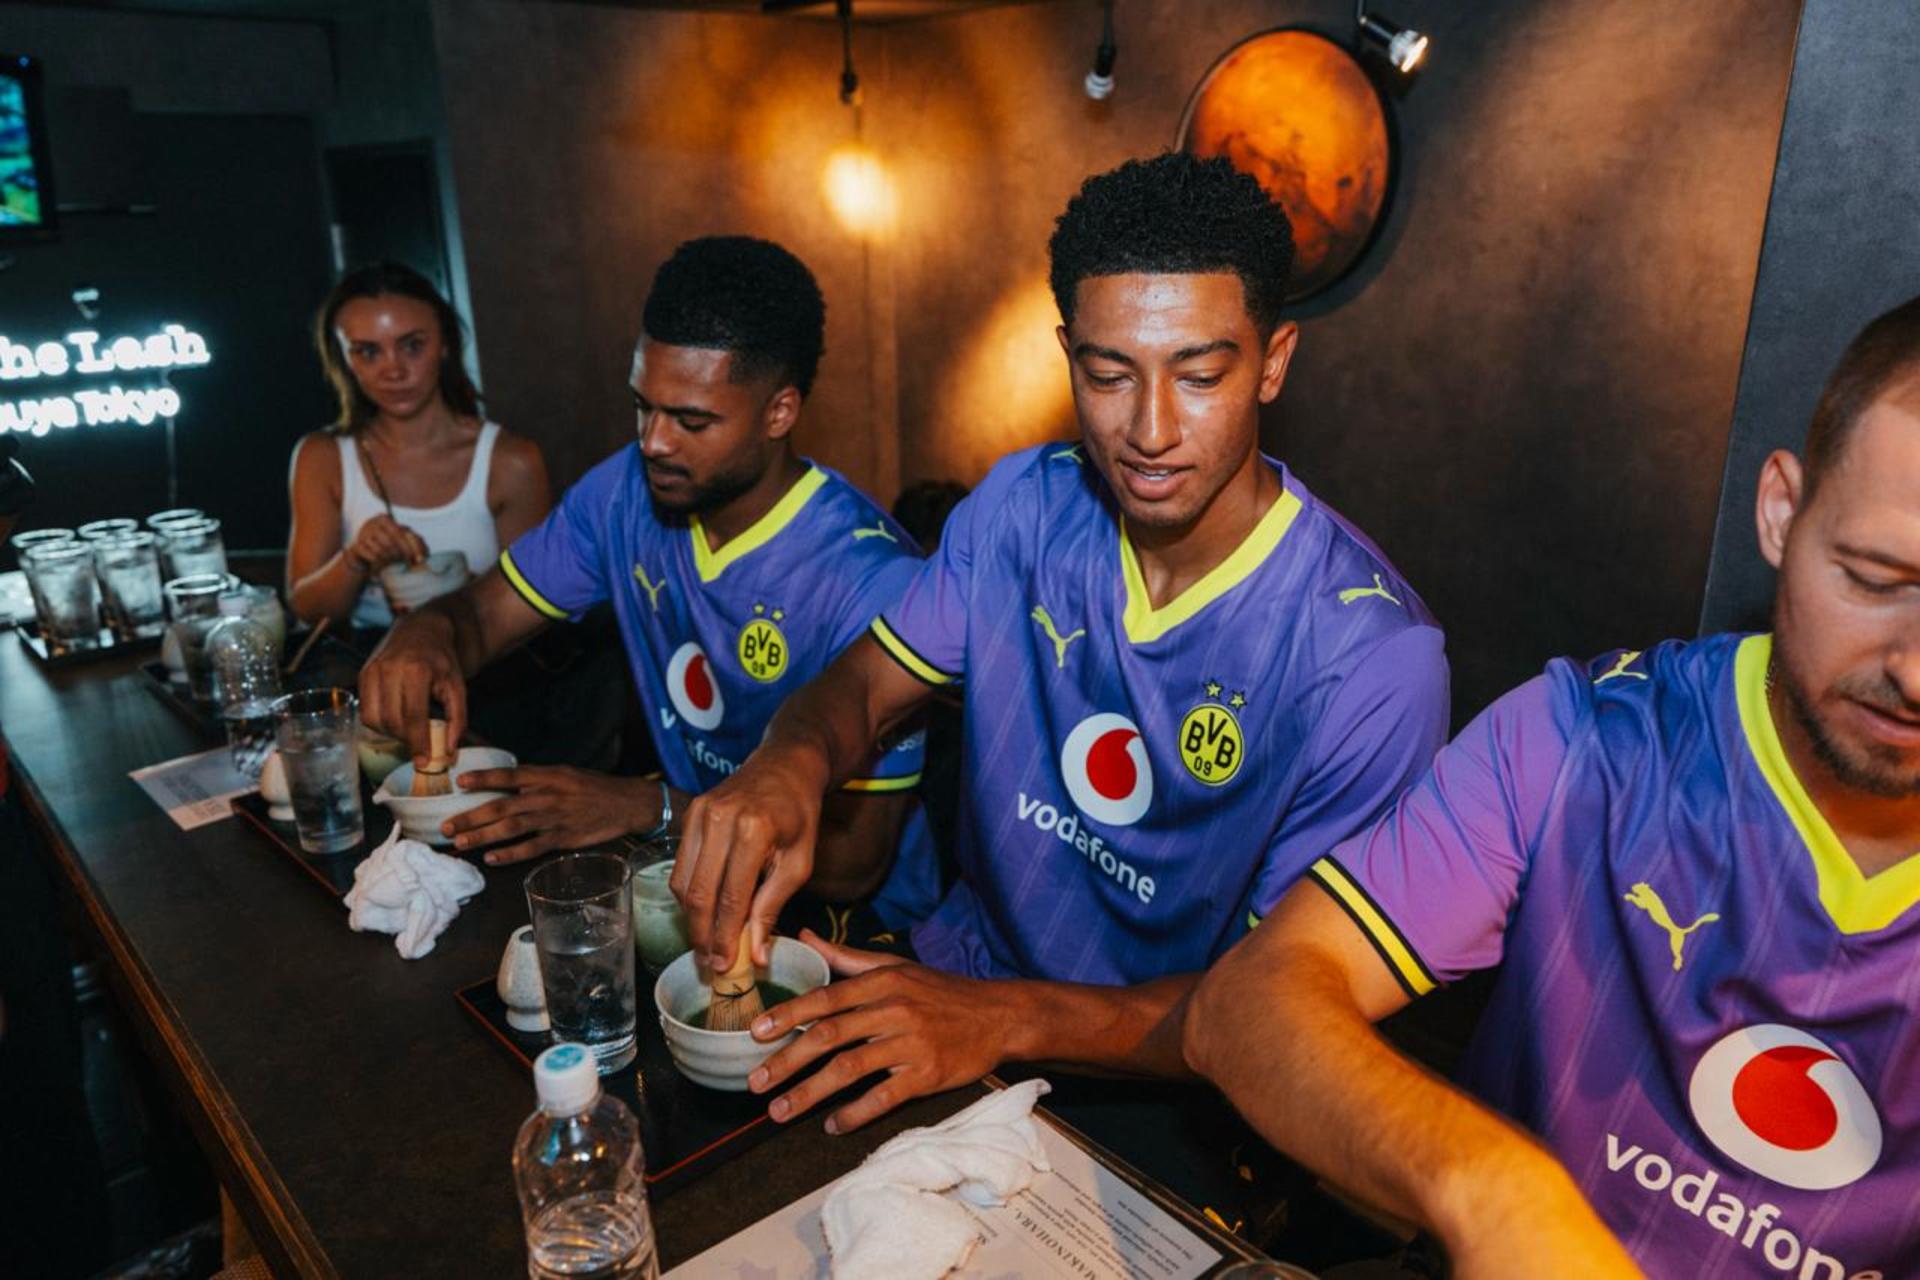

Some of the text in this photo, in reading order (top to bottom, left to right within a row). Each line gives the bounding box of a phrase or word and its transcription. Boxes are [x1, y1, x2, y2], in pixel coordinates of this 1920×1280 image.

[0, 334, 70, 379] he
[0, 385, 181, 437] uya Tokyo
[743, 624, 781, 668] BVB
[1185, 711, 1237, 769] BVB
[1193, 755, 1213, 777] 09
[1017, 792, 1156, 904] vodafone
[1607, 1133, 1883, 1280] vodafon
